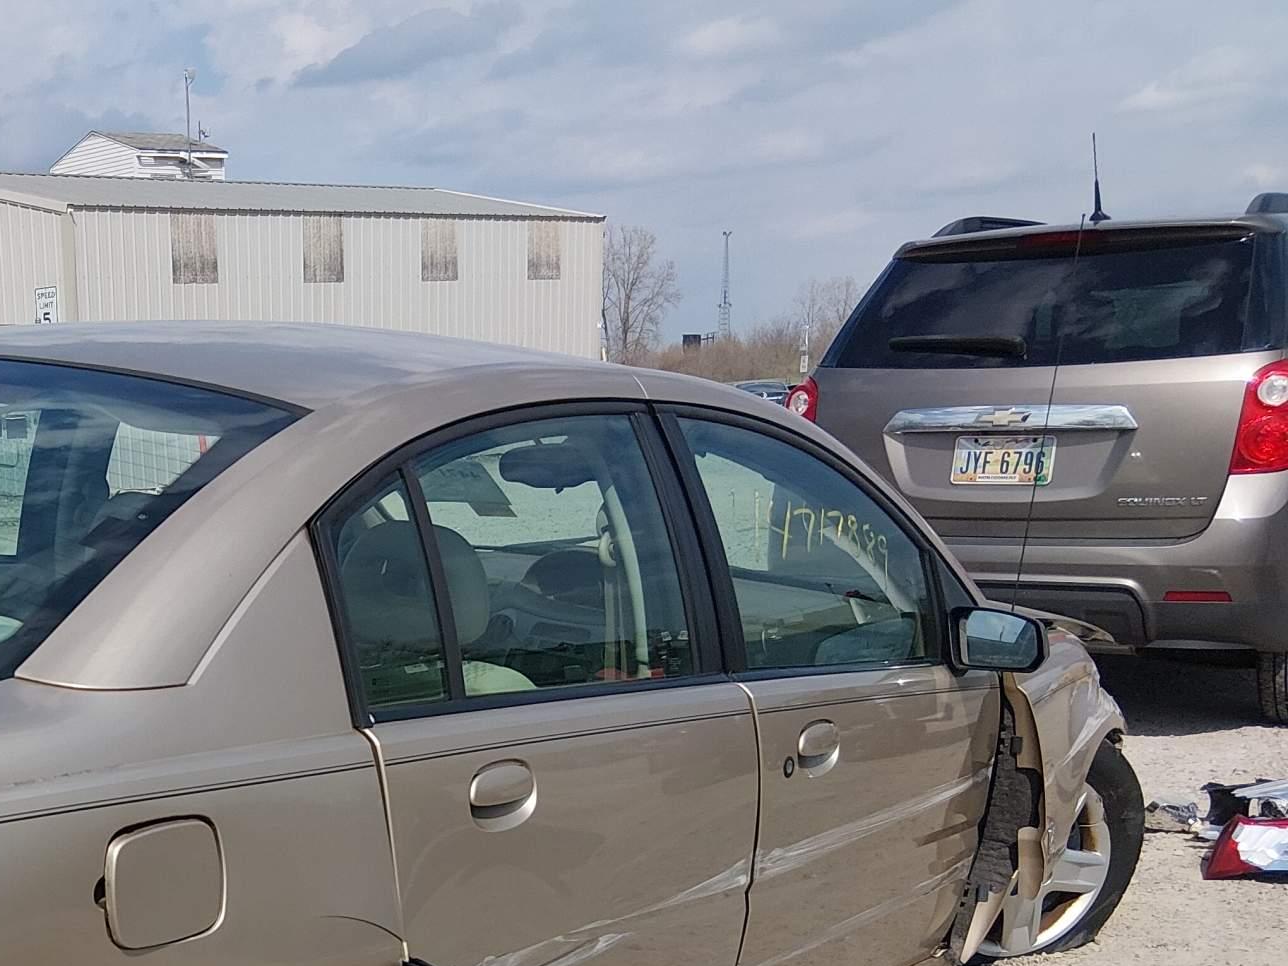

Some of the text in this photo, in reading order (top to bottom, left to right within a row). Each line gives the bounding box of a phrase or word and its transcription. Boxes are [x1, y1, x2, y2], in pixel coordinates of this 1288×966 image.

[37, 291, 56, 300] SPEED
[39, 301, 54, 310] LIMIT
[43, 311, 52, 324] 5
[960, 451, 1045, 474] JYF 6796
[1117, 496, 1208, 507] EQUINOX LT
